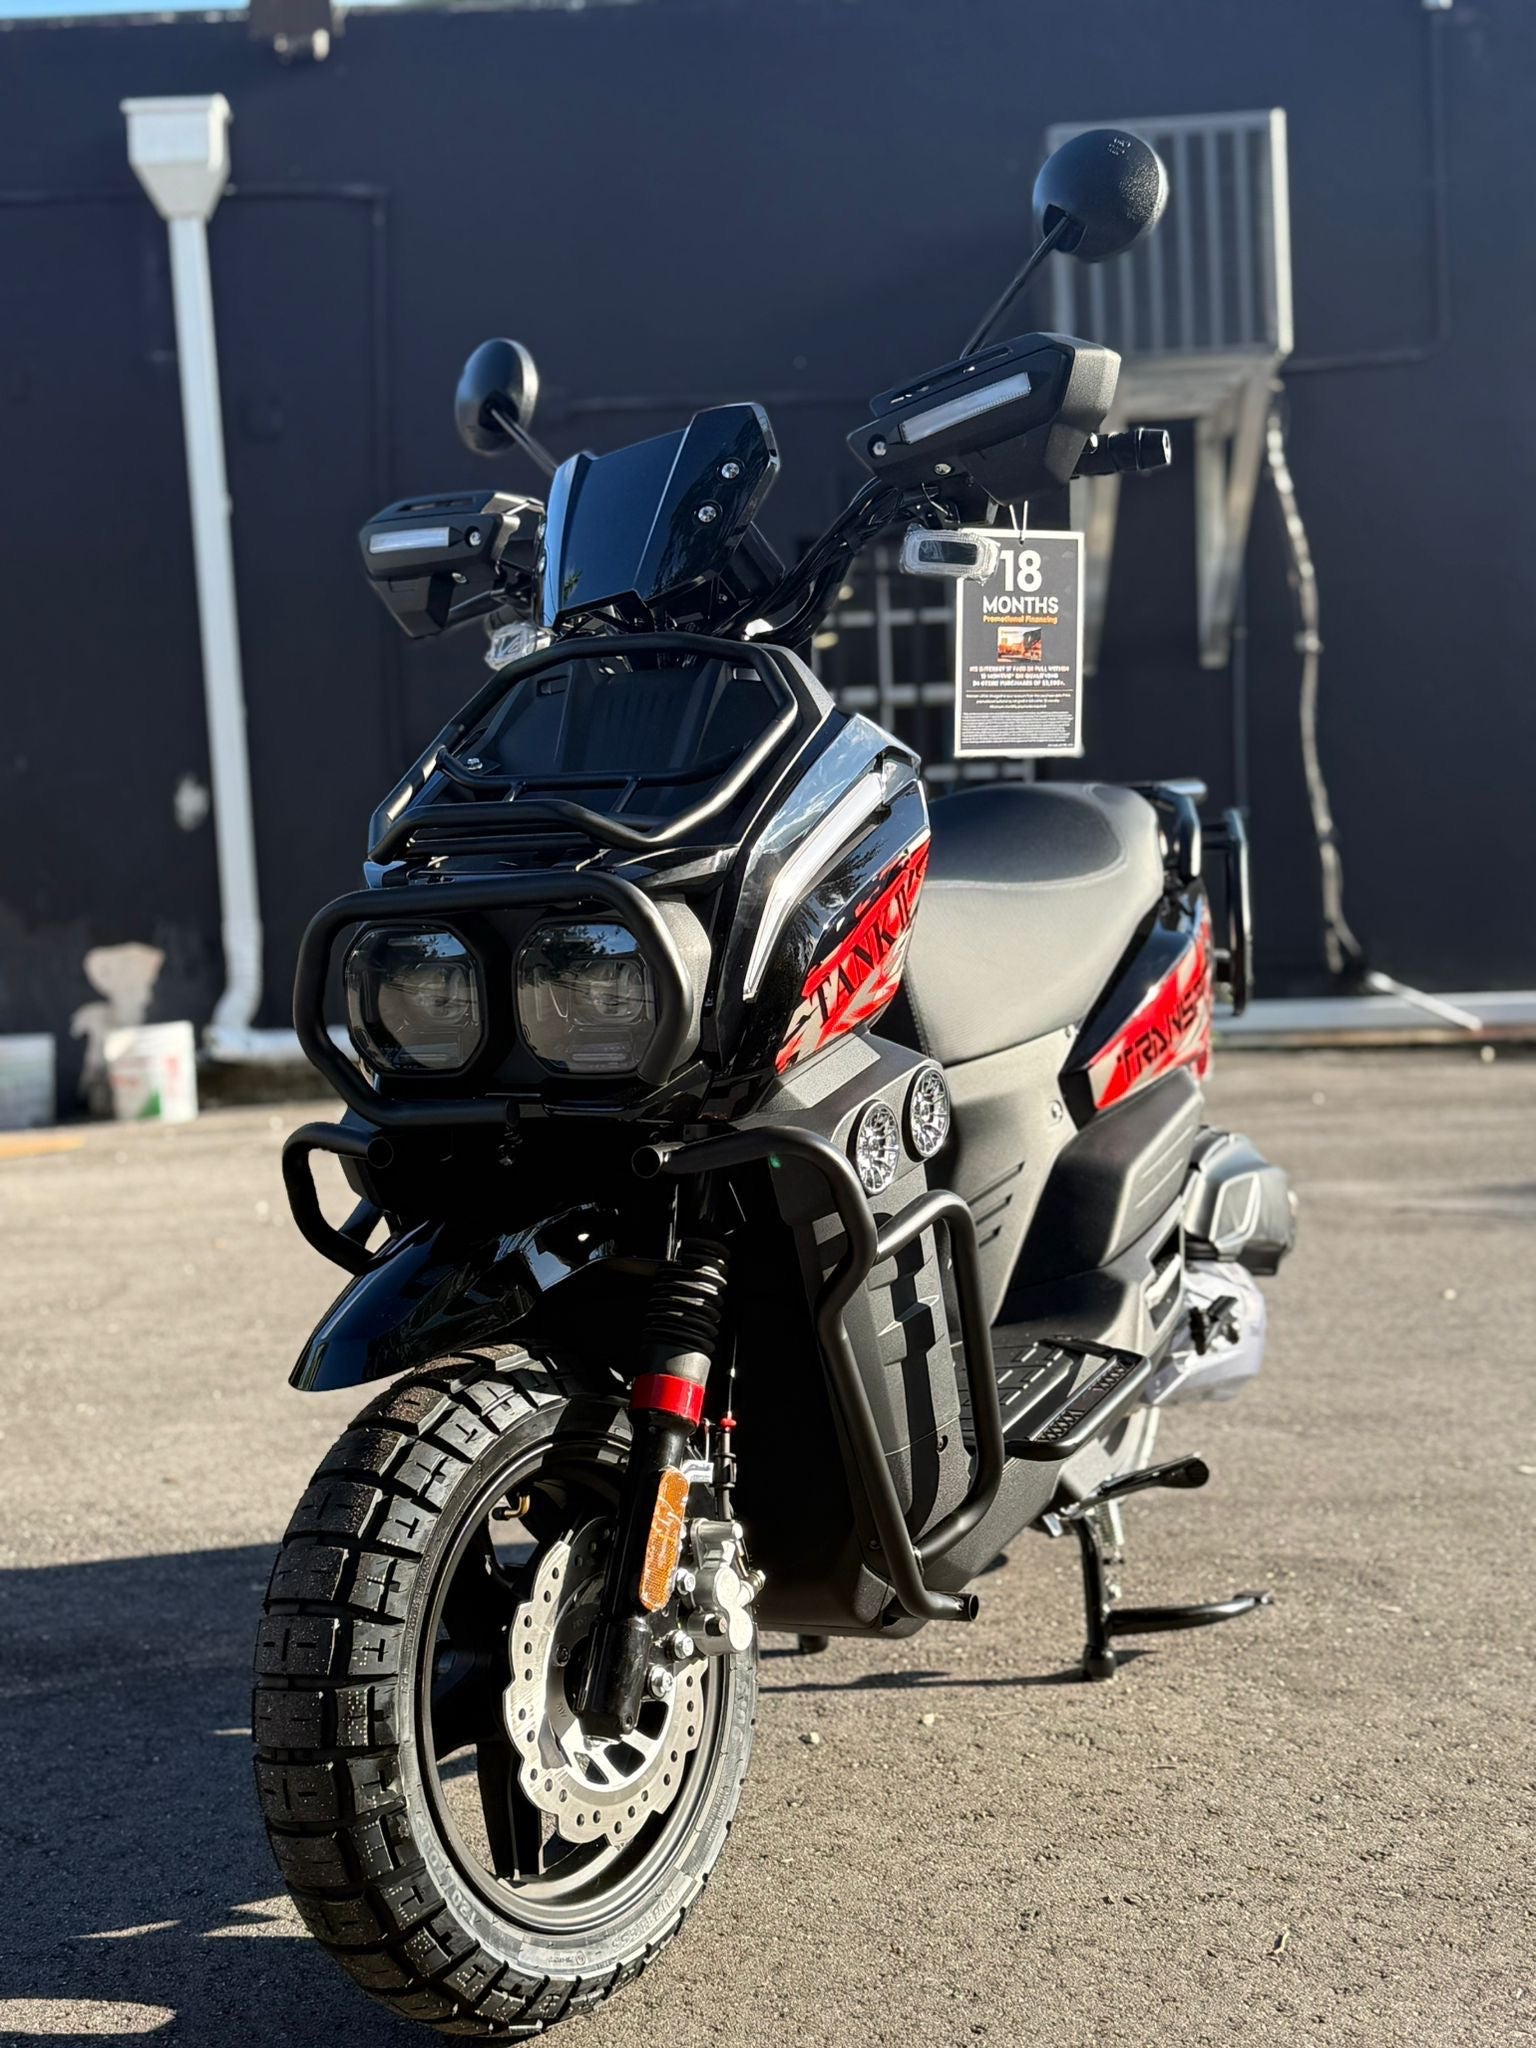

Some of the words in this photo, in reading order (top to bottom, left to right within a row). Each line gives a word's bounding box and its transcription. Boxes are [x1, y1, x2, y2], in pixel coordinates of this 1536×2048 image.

[1000, 549, 1042, 592] 18
[982, 595, 1059, 614] MONTHS
[983, 614, 1025, 624] Promotional
[1025, 614, 1058, 625] Financing
[808, 895, 899, 1028] TANK
[1117, 980, 1204, 1082] TRANS
